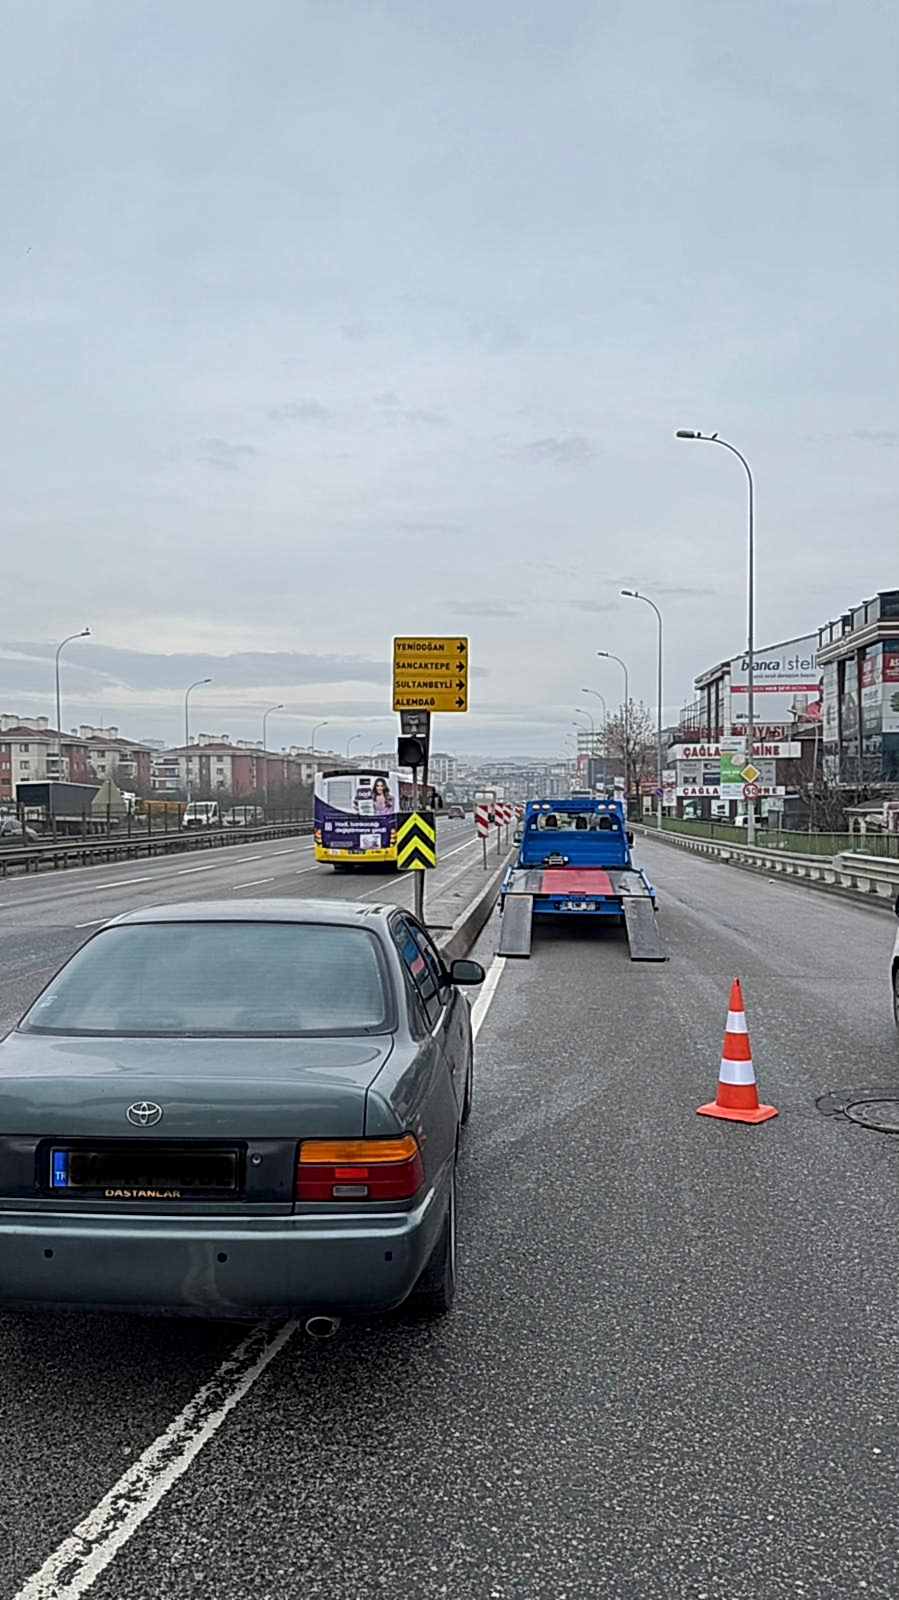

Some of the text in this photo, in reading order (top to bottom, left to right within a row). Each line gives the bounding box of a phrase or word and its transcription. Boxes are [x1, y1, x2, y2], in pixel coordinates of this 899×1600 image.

[397, 642, 445, 651] YENİDOĞAN
[395, 662, 450, 670] SANCAKTEPE
[741, 659, 780, 671] banca
[395, 680, 452, 688] SULTANBEYLİ
[395, 697, 436, 706] ALEMDAĞ
[683, 743, 721, 758] ÇAĞLA
[751, 742, 780, 756] MİNE
[683, 786, 719, 795] ÇAĞLA
[105, 1189, 181, 1198] DASTANLAR
